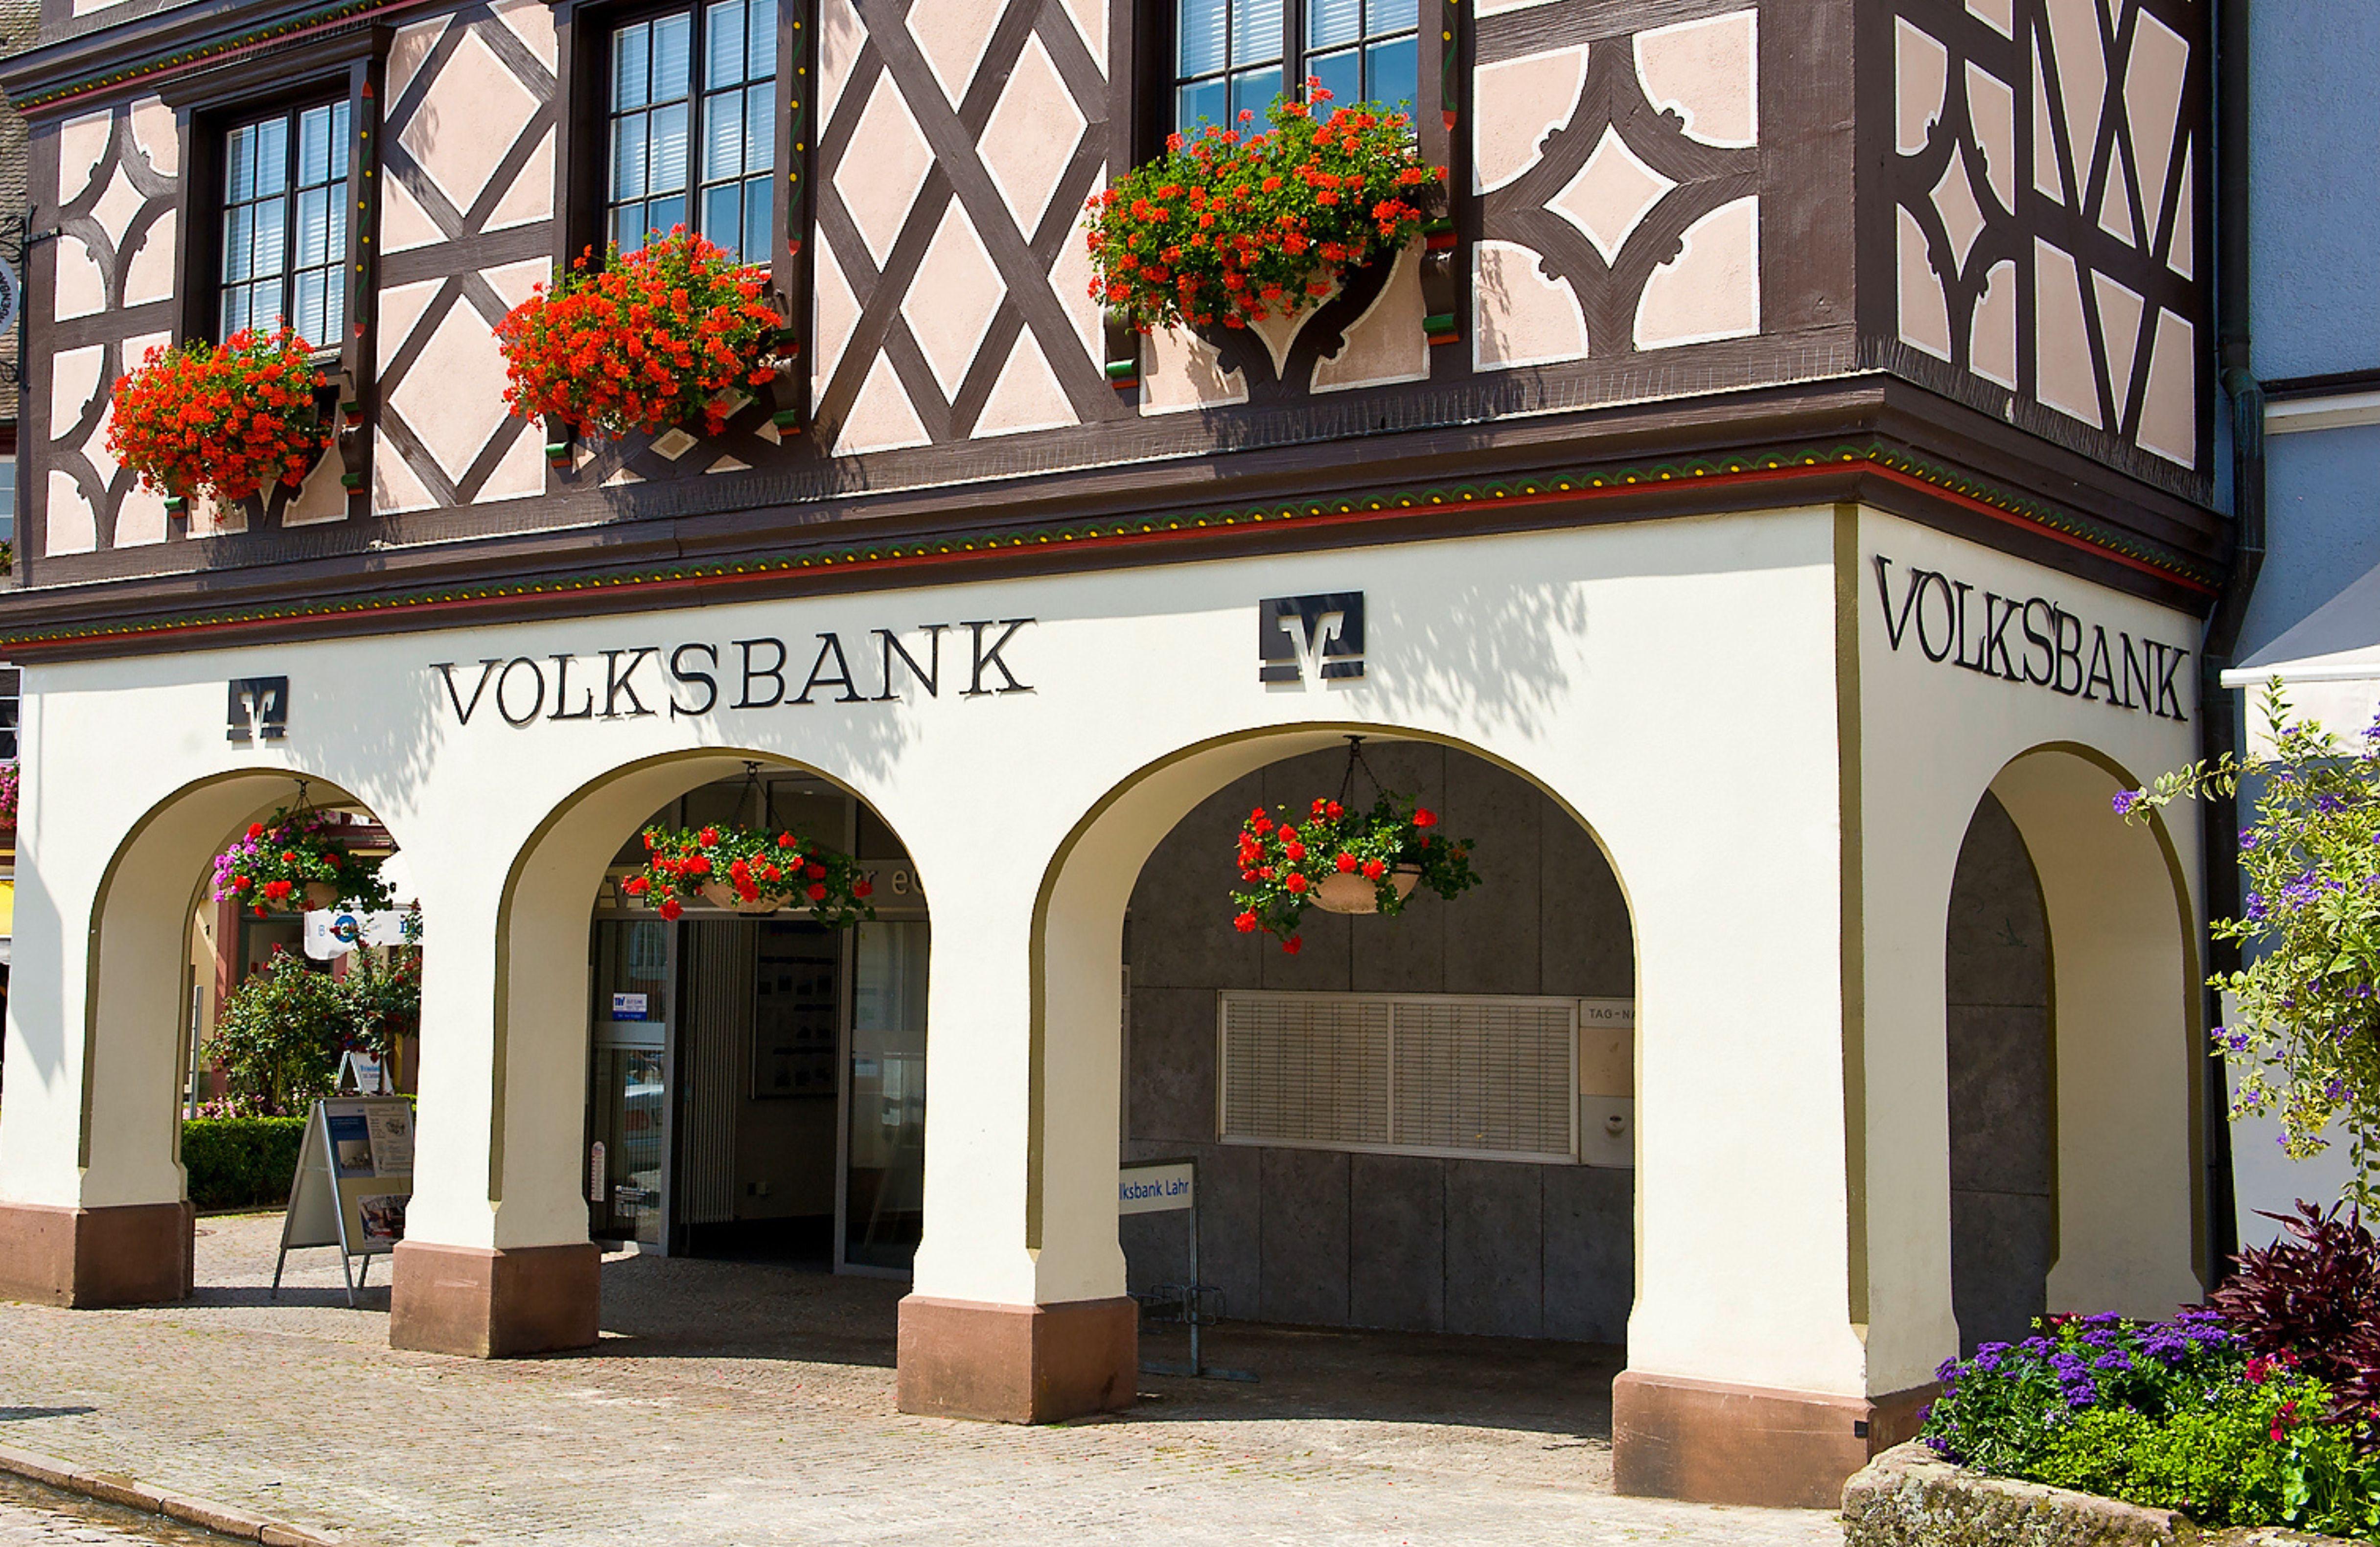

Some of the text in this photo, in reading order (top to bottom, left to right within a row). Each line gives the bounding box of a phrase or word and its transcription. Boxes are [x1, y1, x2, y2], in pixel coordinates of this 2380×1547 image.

[430, 618, 1038, 726] VOLKSBANK
[1873, 554, 2190, 722] VOLKSBANK
[1119, 1178, 1189, 1200] lksbank Lahr
